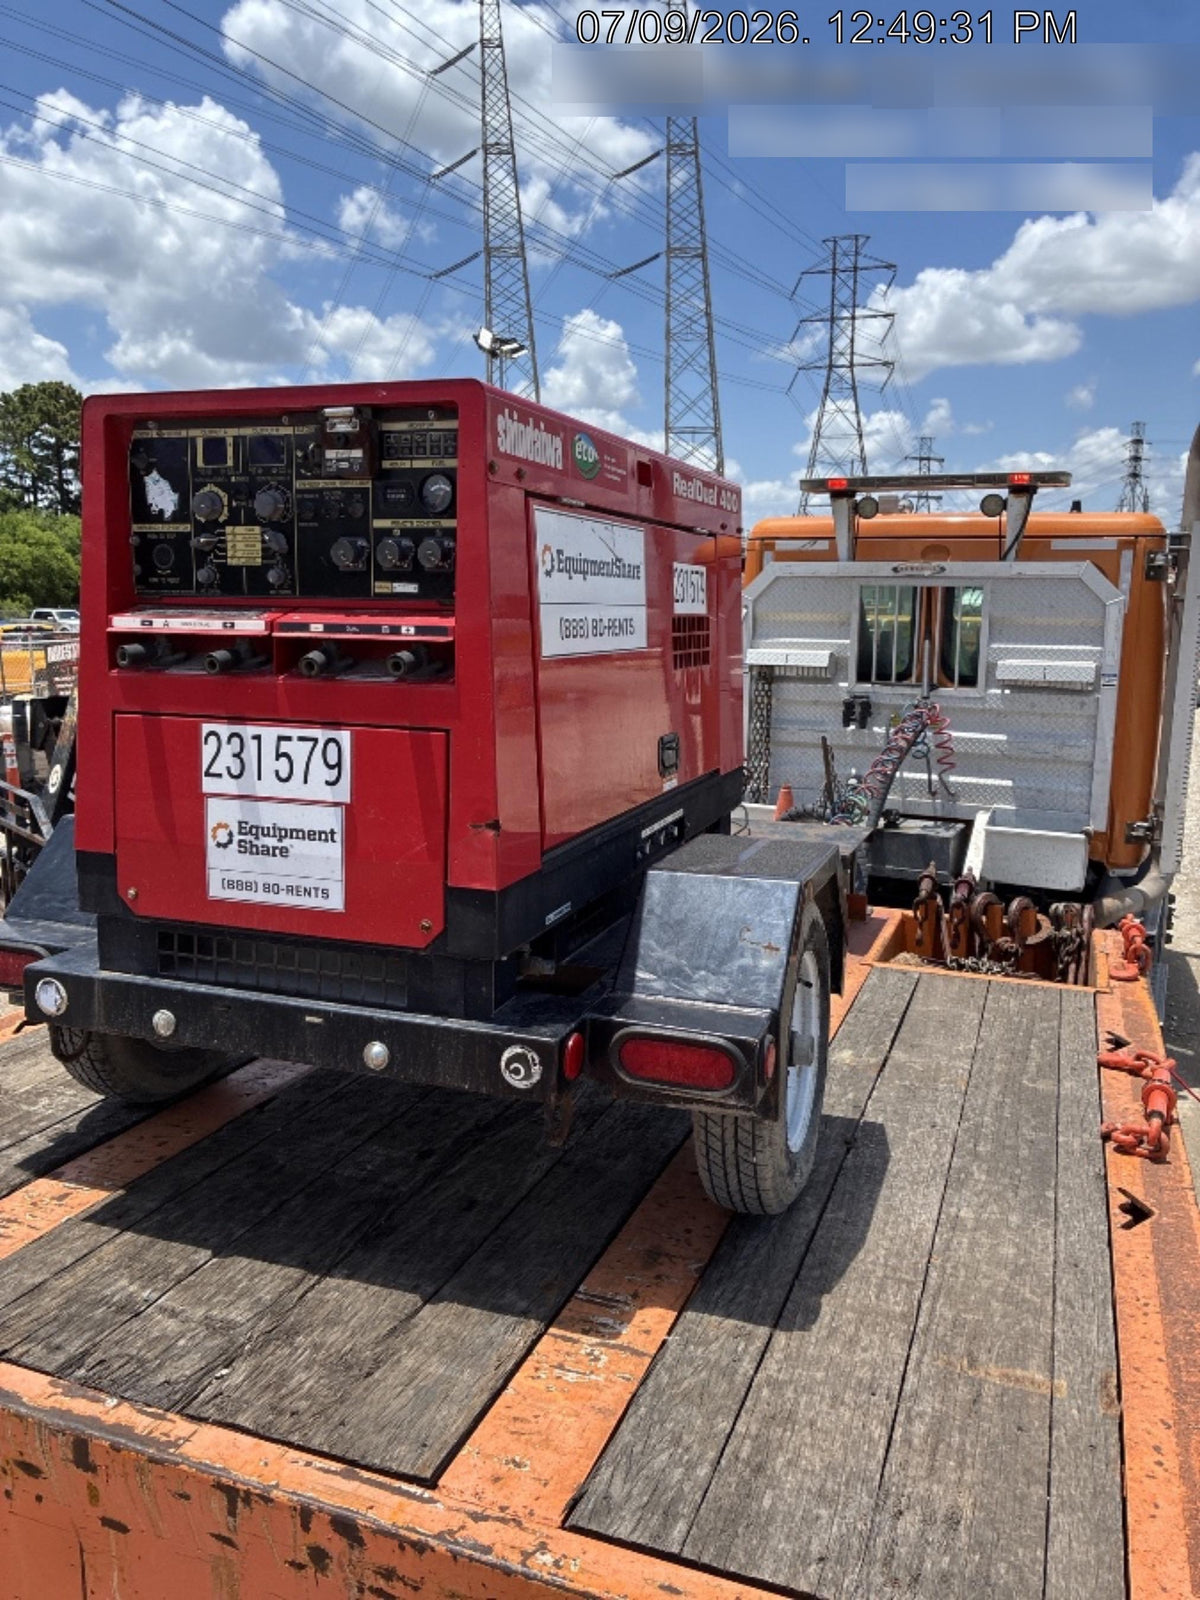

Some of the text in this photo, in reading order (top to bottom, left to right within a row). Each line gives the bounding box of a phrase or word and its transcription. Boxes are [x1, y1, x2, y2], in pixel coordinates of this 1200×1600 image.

[497, 408, 563, 470] shindaiwa
[556, 549, 641, 581] EquipmentShare
[203, 730, 343, 786] 231579
[237, 821, 337, 843] Equipment
[237, 839, 291, 858] Share
[221, 878, 330, 899] (888) 80-RENTS
